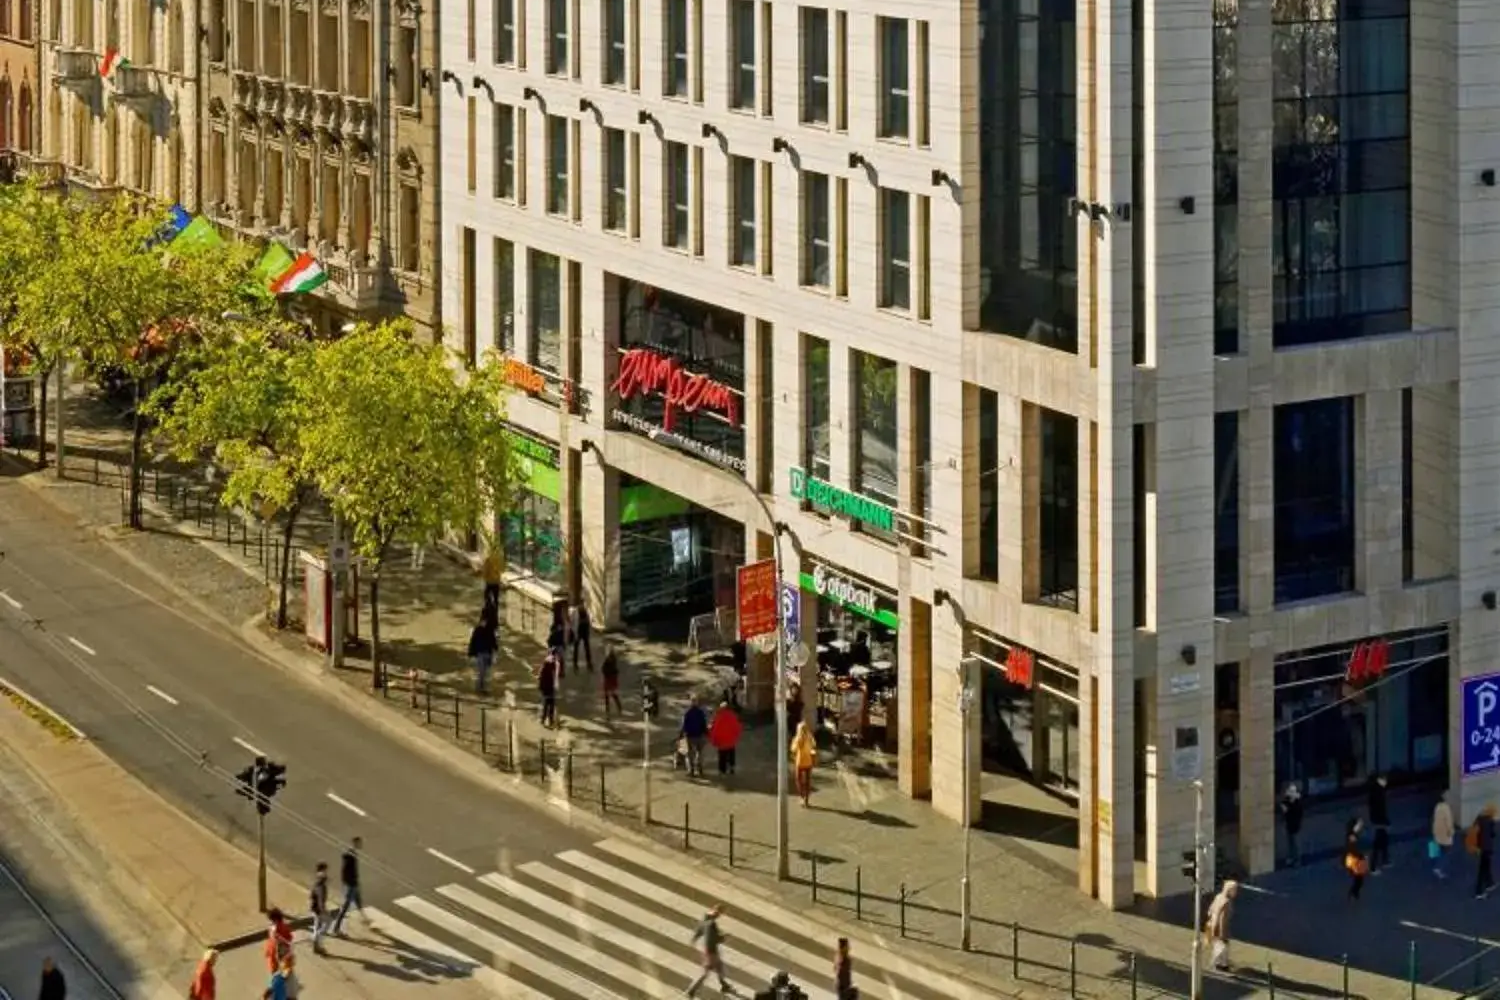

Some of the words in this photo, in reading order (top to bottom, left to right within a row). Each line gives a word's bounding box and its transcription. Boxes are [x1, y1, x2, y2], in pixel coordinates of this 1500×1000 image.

[807, 475, 893, 532] DEICHMANN
[1478, 690, 1497, 726] P
[1471, 724, 1500, 746] 0-24
